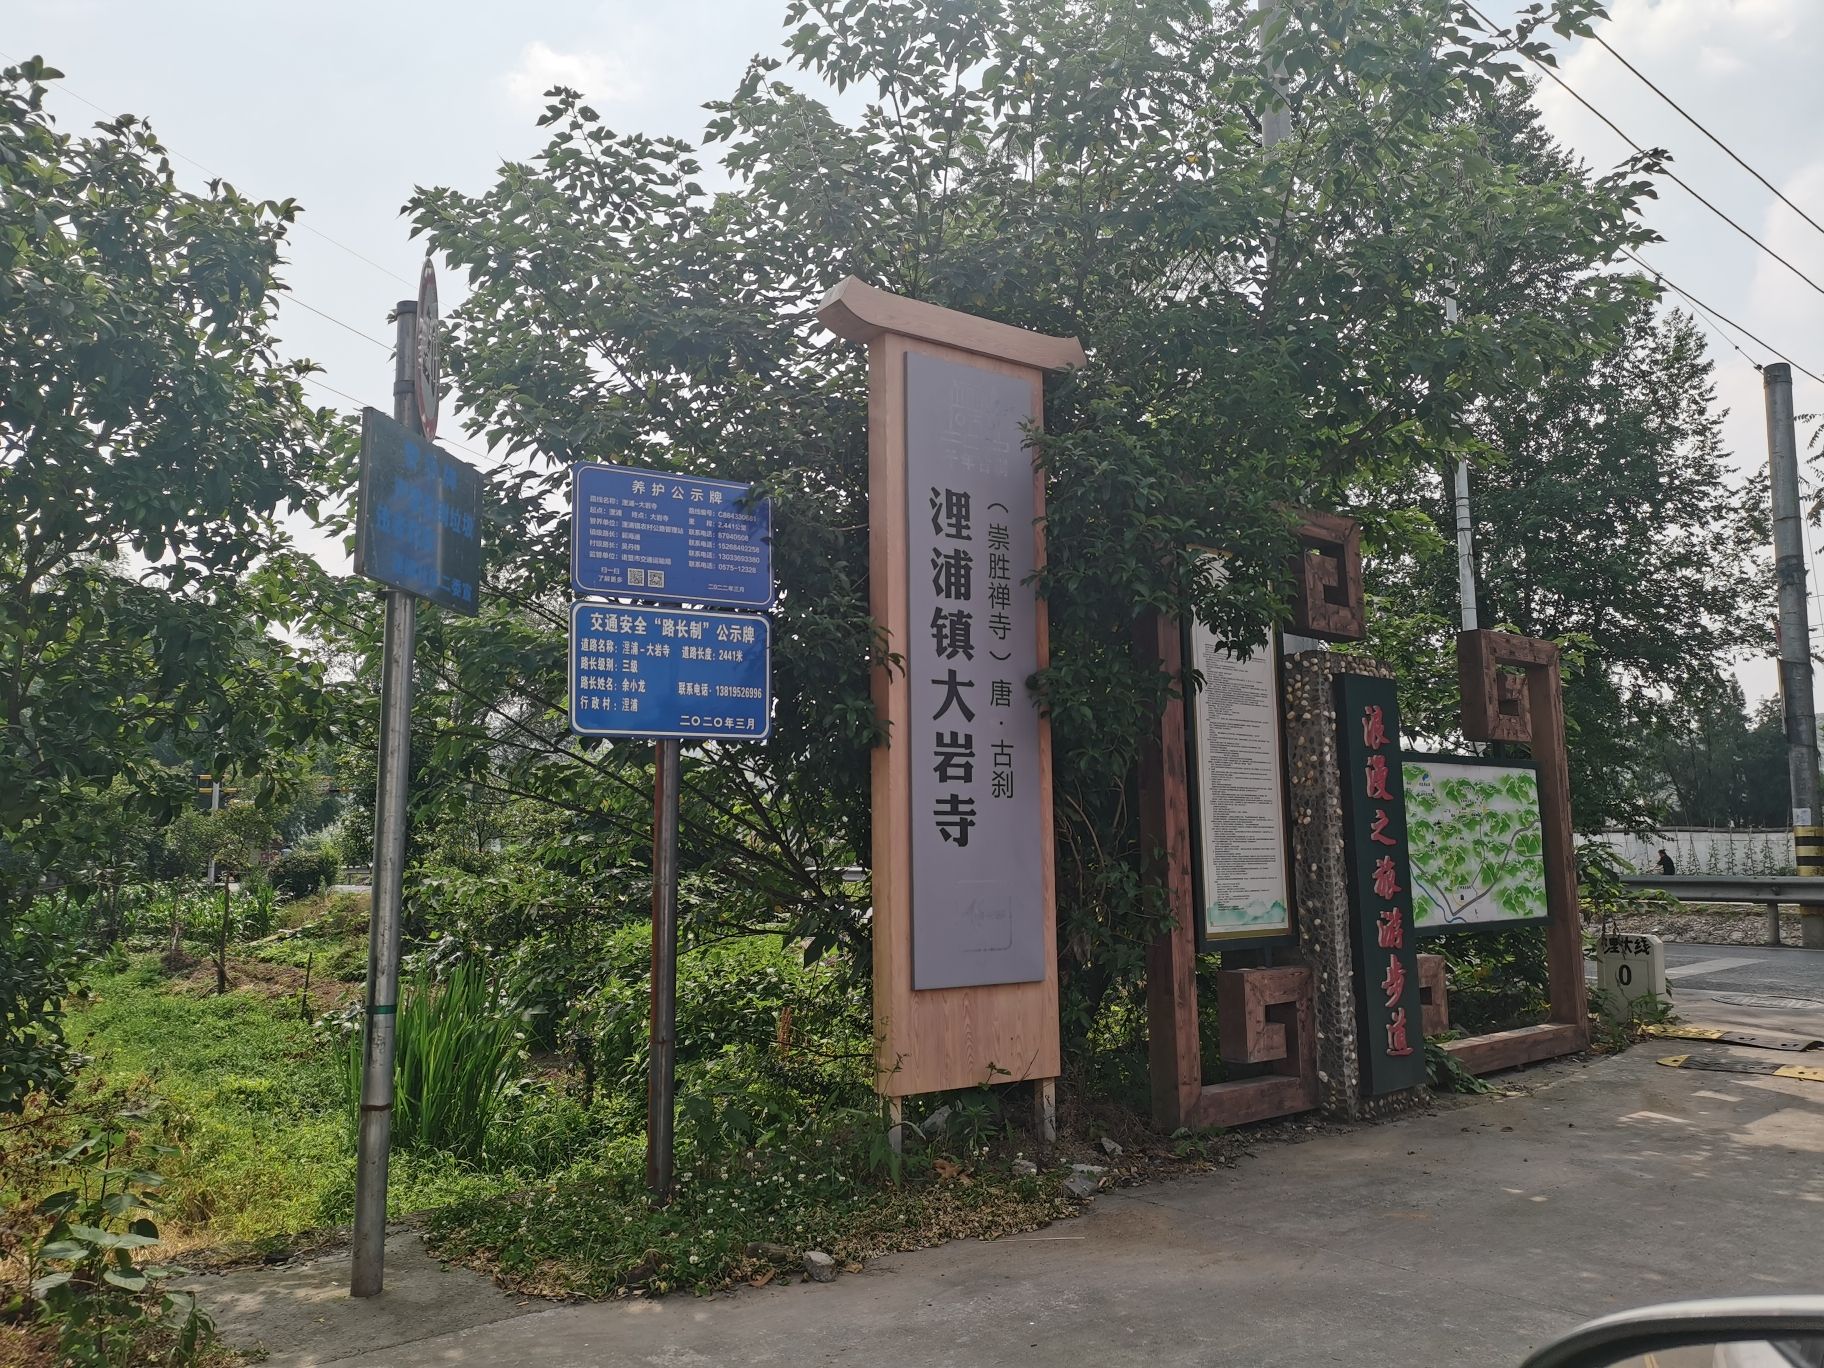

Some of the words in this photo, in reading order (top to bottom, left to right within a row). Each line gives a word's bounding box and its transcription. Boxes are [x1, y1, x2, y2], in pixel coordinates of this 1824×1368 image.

[632, 479, 724, 504] 养护公示牌
[929, 486, 977, 848] 浬浦镇大岩寺
[1618, 964, 1632, 986] 0
